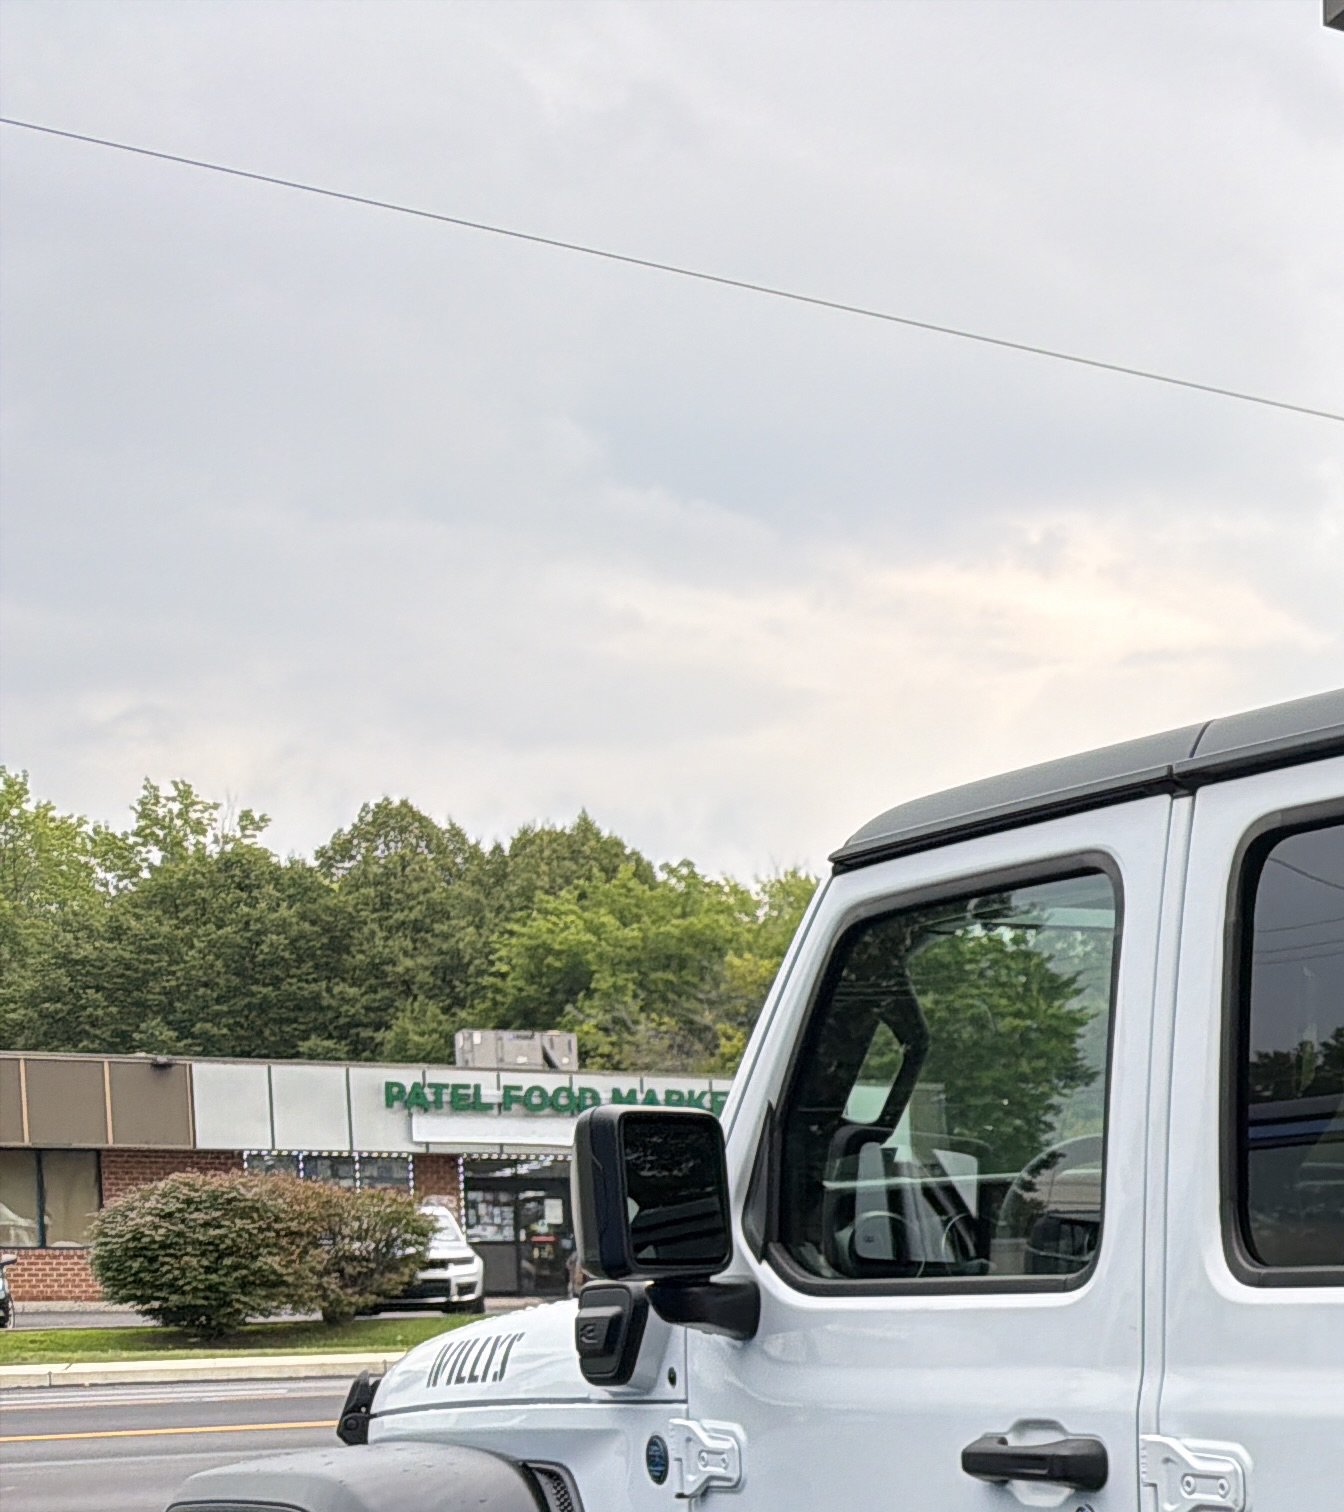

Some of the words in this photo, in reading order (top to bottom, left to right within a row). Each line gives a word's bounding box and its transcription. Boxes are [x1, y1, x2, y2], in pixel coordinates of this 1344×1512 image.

[384, 1081, 493, 1113] PATEL
[503, 1085, 600, 1114] FOOD
[426, 1332, 526, 1388] WILLYS
